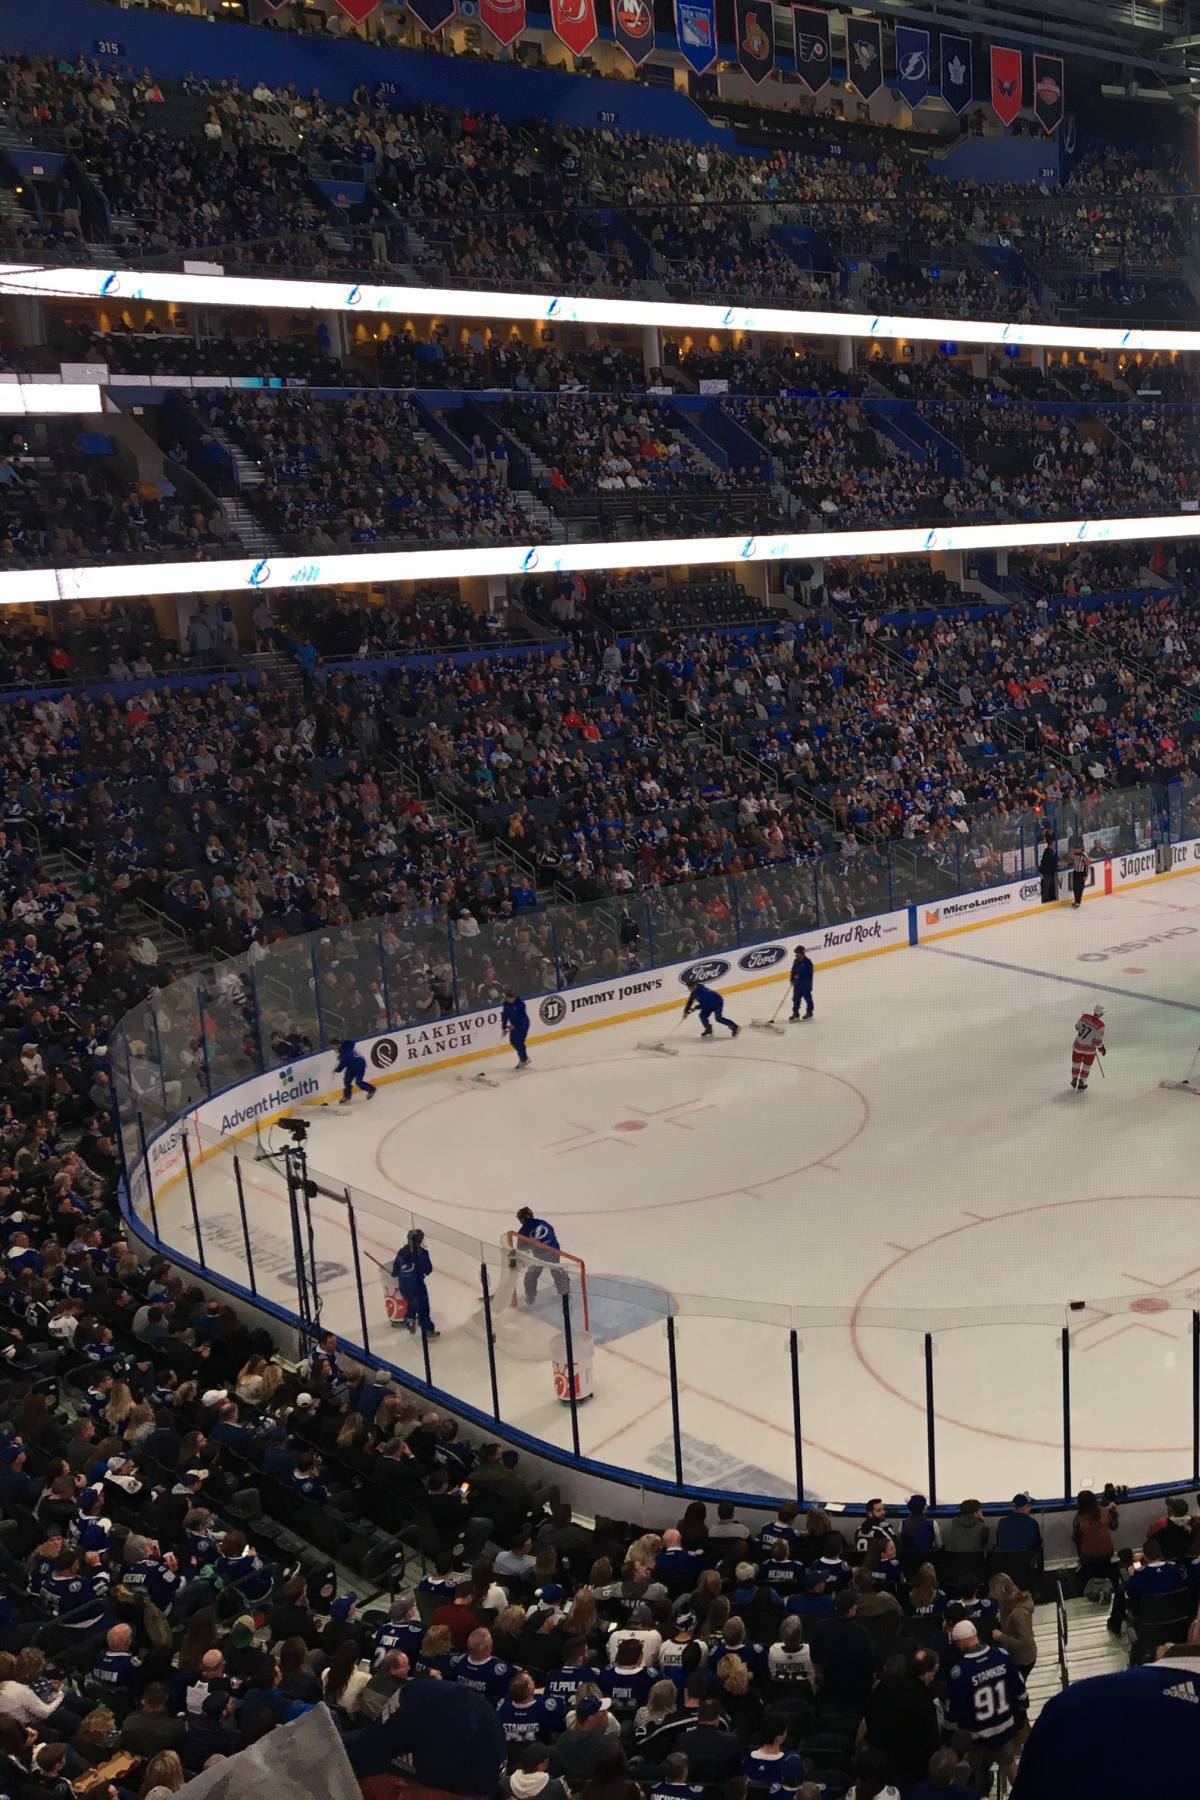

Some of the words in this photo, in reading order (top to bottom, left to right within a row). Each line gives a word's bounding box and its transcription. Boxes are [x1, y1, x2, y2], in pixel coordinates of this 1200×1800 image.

[98, 41, 119, 56] 315
[601, 111, 615, 124] 317
[1024, 884, 1038, 896] FOX
[943, 892, 1011, 916] MicroLumen
[823, 926, 853, 949] Hard
[853, 920, 883, 944] Rock
[746, 948, 778, 969] Ford
[570, 990, 616, 1013] JIMMY
[618, 978, 663, 1001] JOHN'S
[406, 1012, 500, 1046] LAKEWOO
[1078, 1023, 1093, 1040] 37
[407, 1033, 473, 1061] RANCH
[220, 1076, 320, 1136] AdventHealth
[971, 1663, 1008, 1687] STAMKOS
[973, 1680, 1010, 1723] 91
